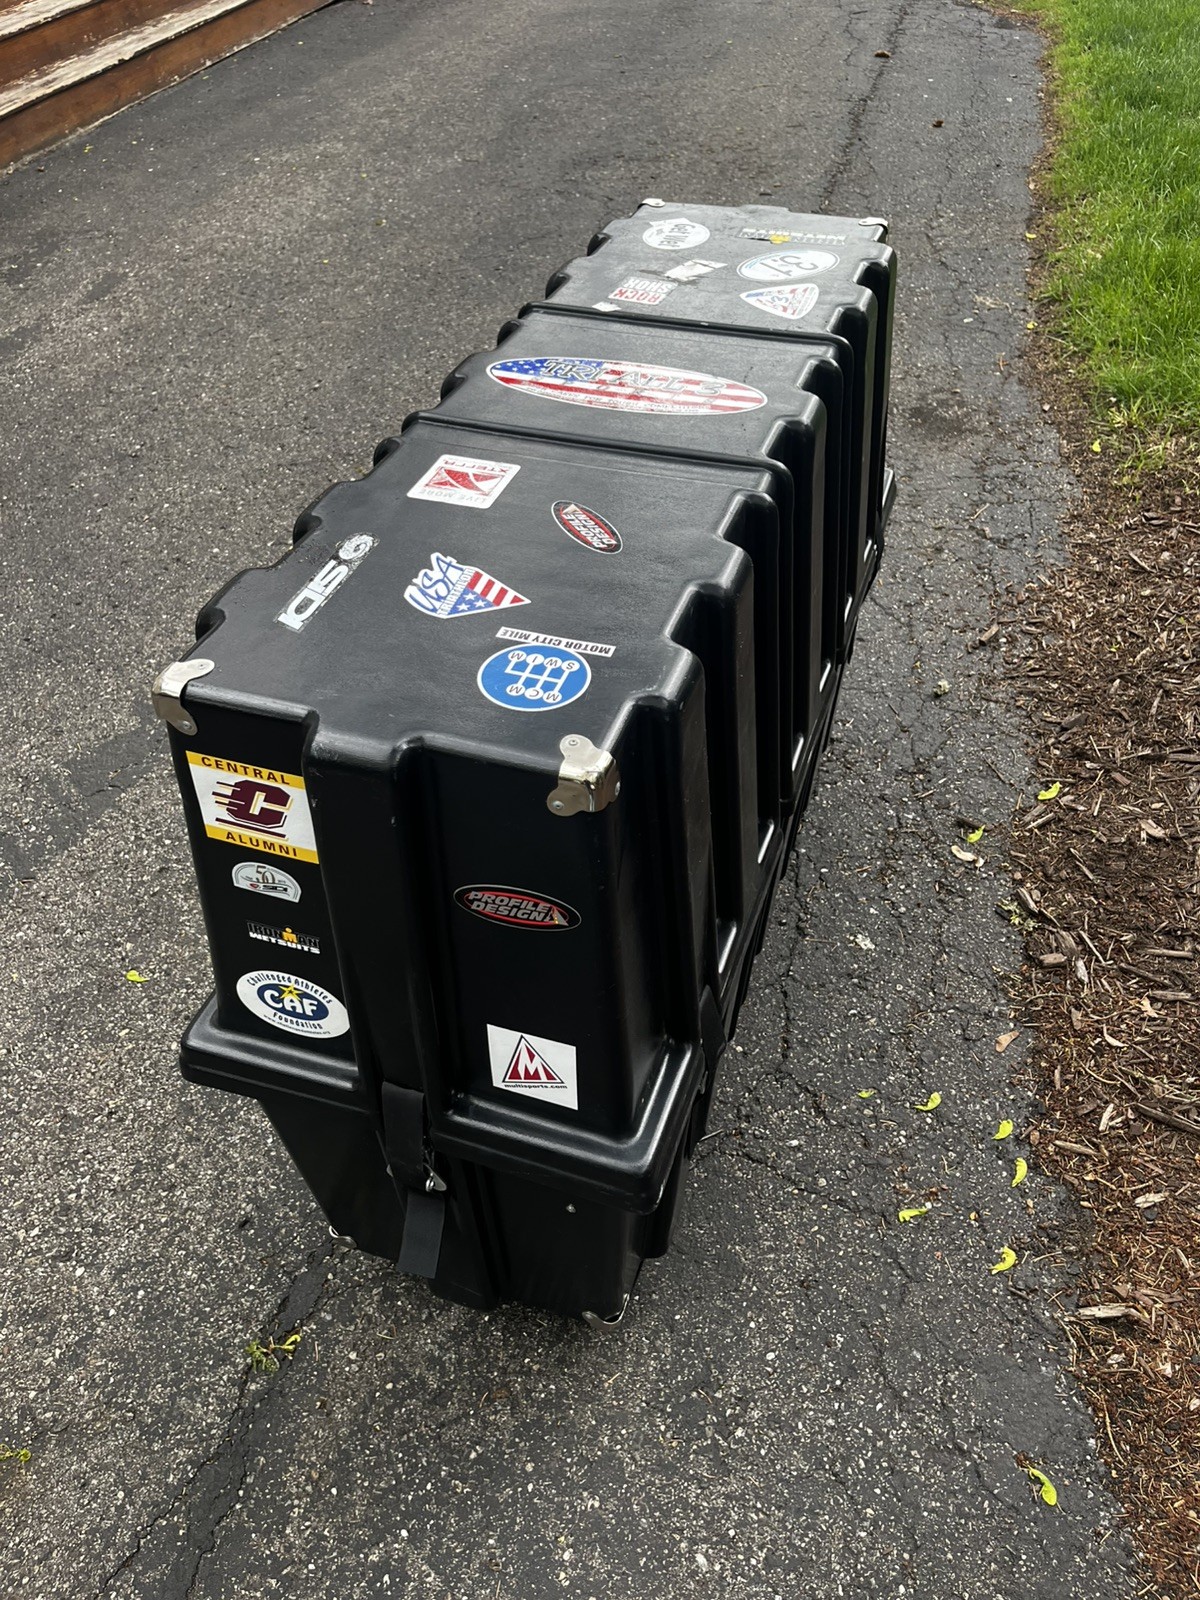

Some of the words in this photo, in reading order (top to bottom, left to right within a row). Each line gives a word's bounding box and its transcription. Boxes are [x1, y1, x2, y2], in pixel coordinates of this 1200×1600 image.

[760, 255, 818, 277] 3.1
[613, 288, 662, 304] ROCK
[561, 513, 608, 548] PROFILE
[409, 555, 465, 614] USA
[501, 628, 531, 640] MILE
[532, 636, 562, 647] CITY
[564, 640, 612, 655] MOTOR
[201, 756, 290, 785] CENTRAL
[226, 832, 298, 857] ALUMNI
[468, 891, 552, 913] PROFILE
[470, 901, 545, 922] DESIGN
[247, 922, 320, 948] IRONMAN
[249, 932, 321, 954] WETSUITS
[247, 972, 292, 986] Challenged
[294, 978, 333, 1004] Athletes
[263, 989, 318, 1016] CAF
[273, 1011, 323, 1030] Foundation
